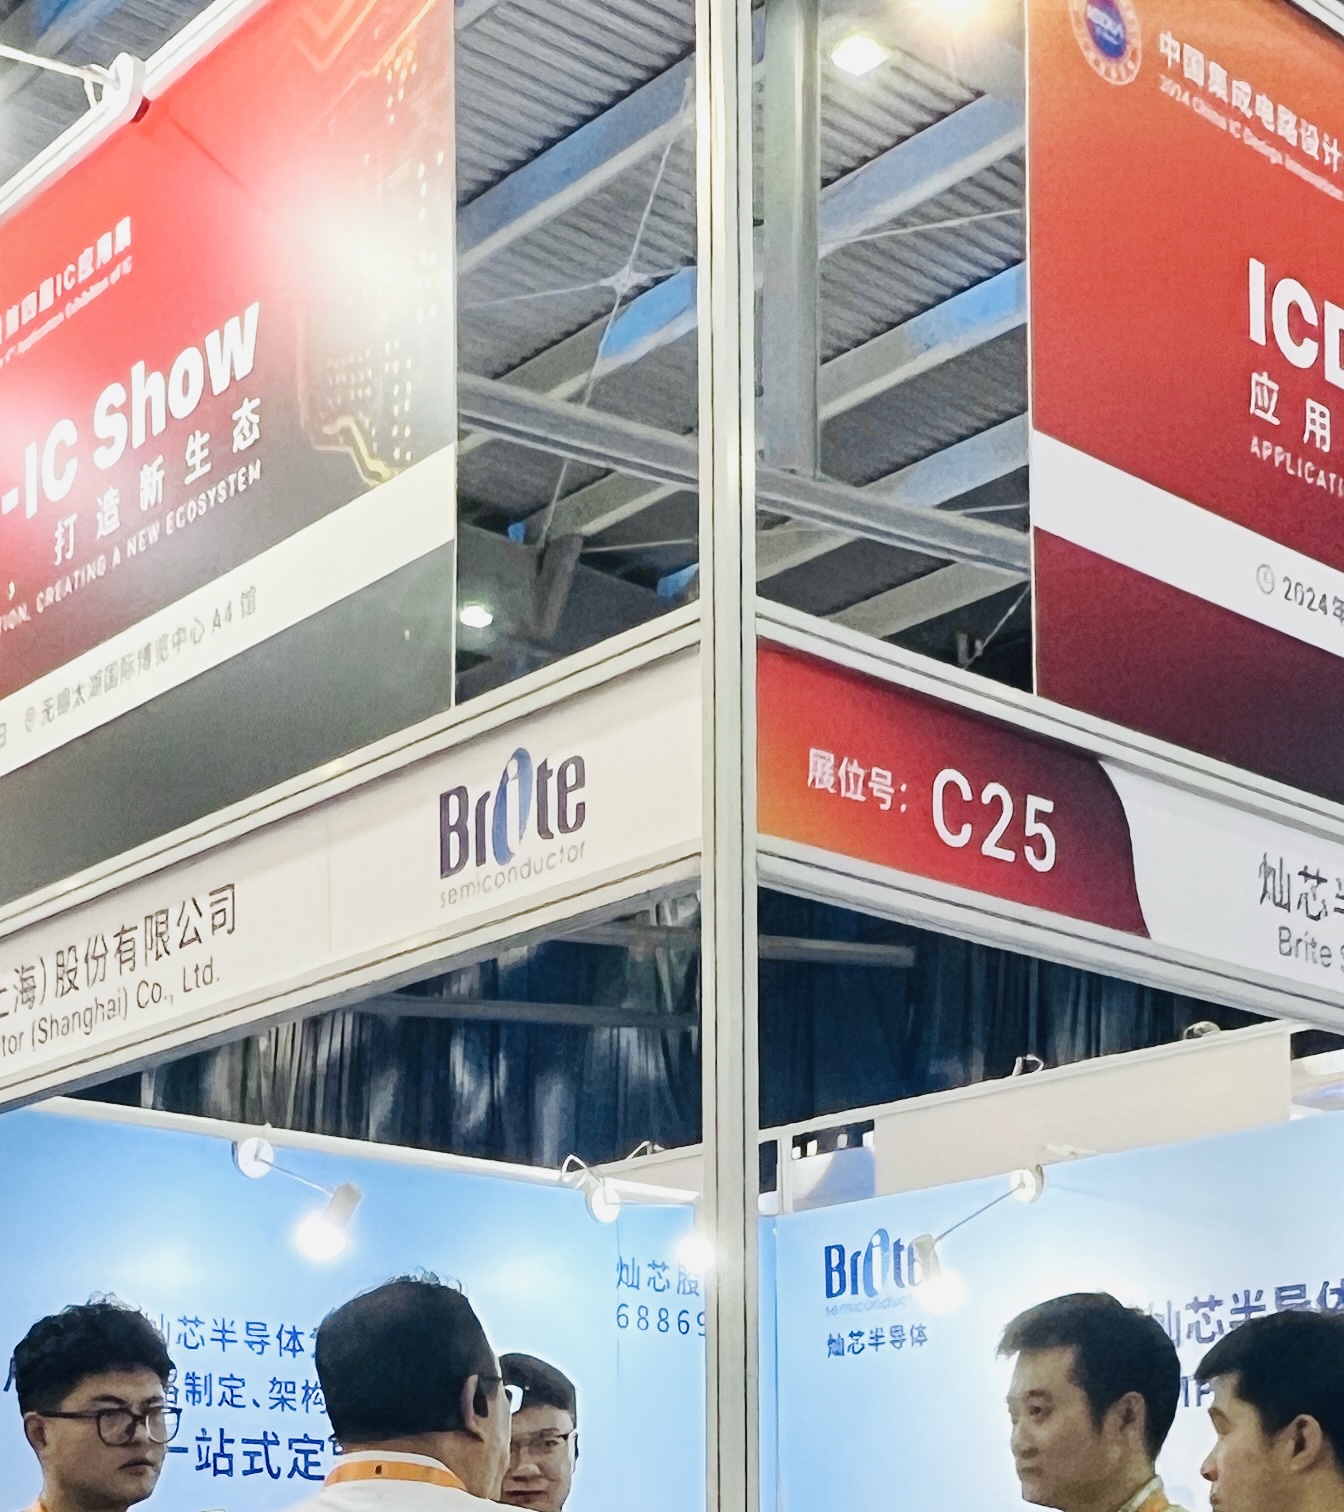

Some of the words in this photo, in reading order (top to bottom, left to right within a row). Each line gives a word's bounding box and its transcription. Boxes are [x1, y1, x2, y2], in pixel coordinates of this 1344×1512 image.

[93, 302, 260, 471] Show
[440, 747, 586, 879] Brite
[932, 768, 1056, 873] C25
[1278, 926, 1332, 968] Brite
[32, 986, 129, 1048] (Shanghai)
[182, 956, 221, 994] Ltd.
[827, 1323, 929, 1358] 灿芯半导体
